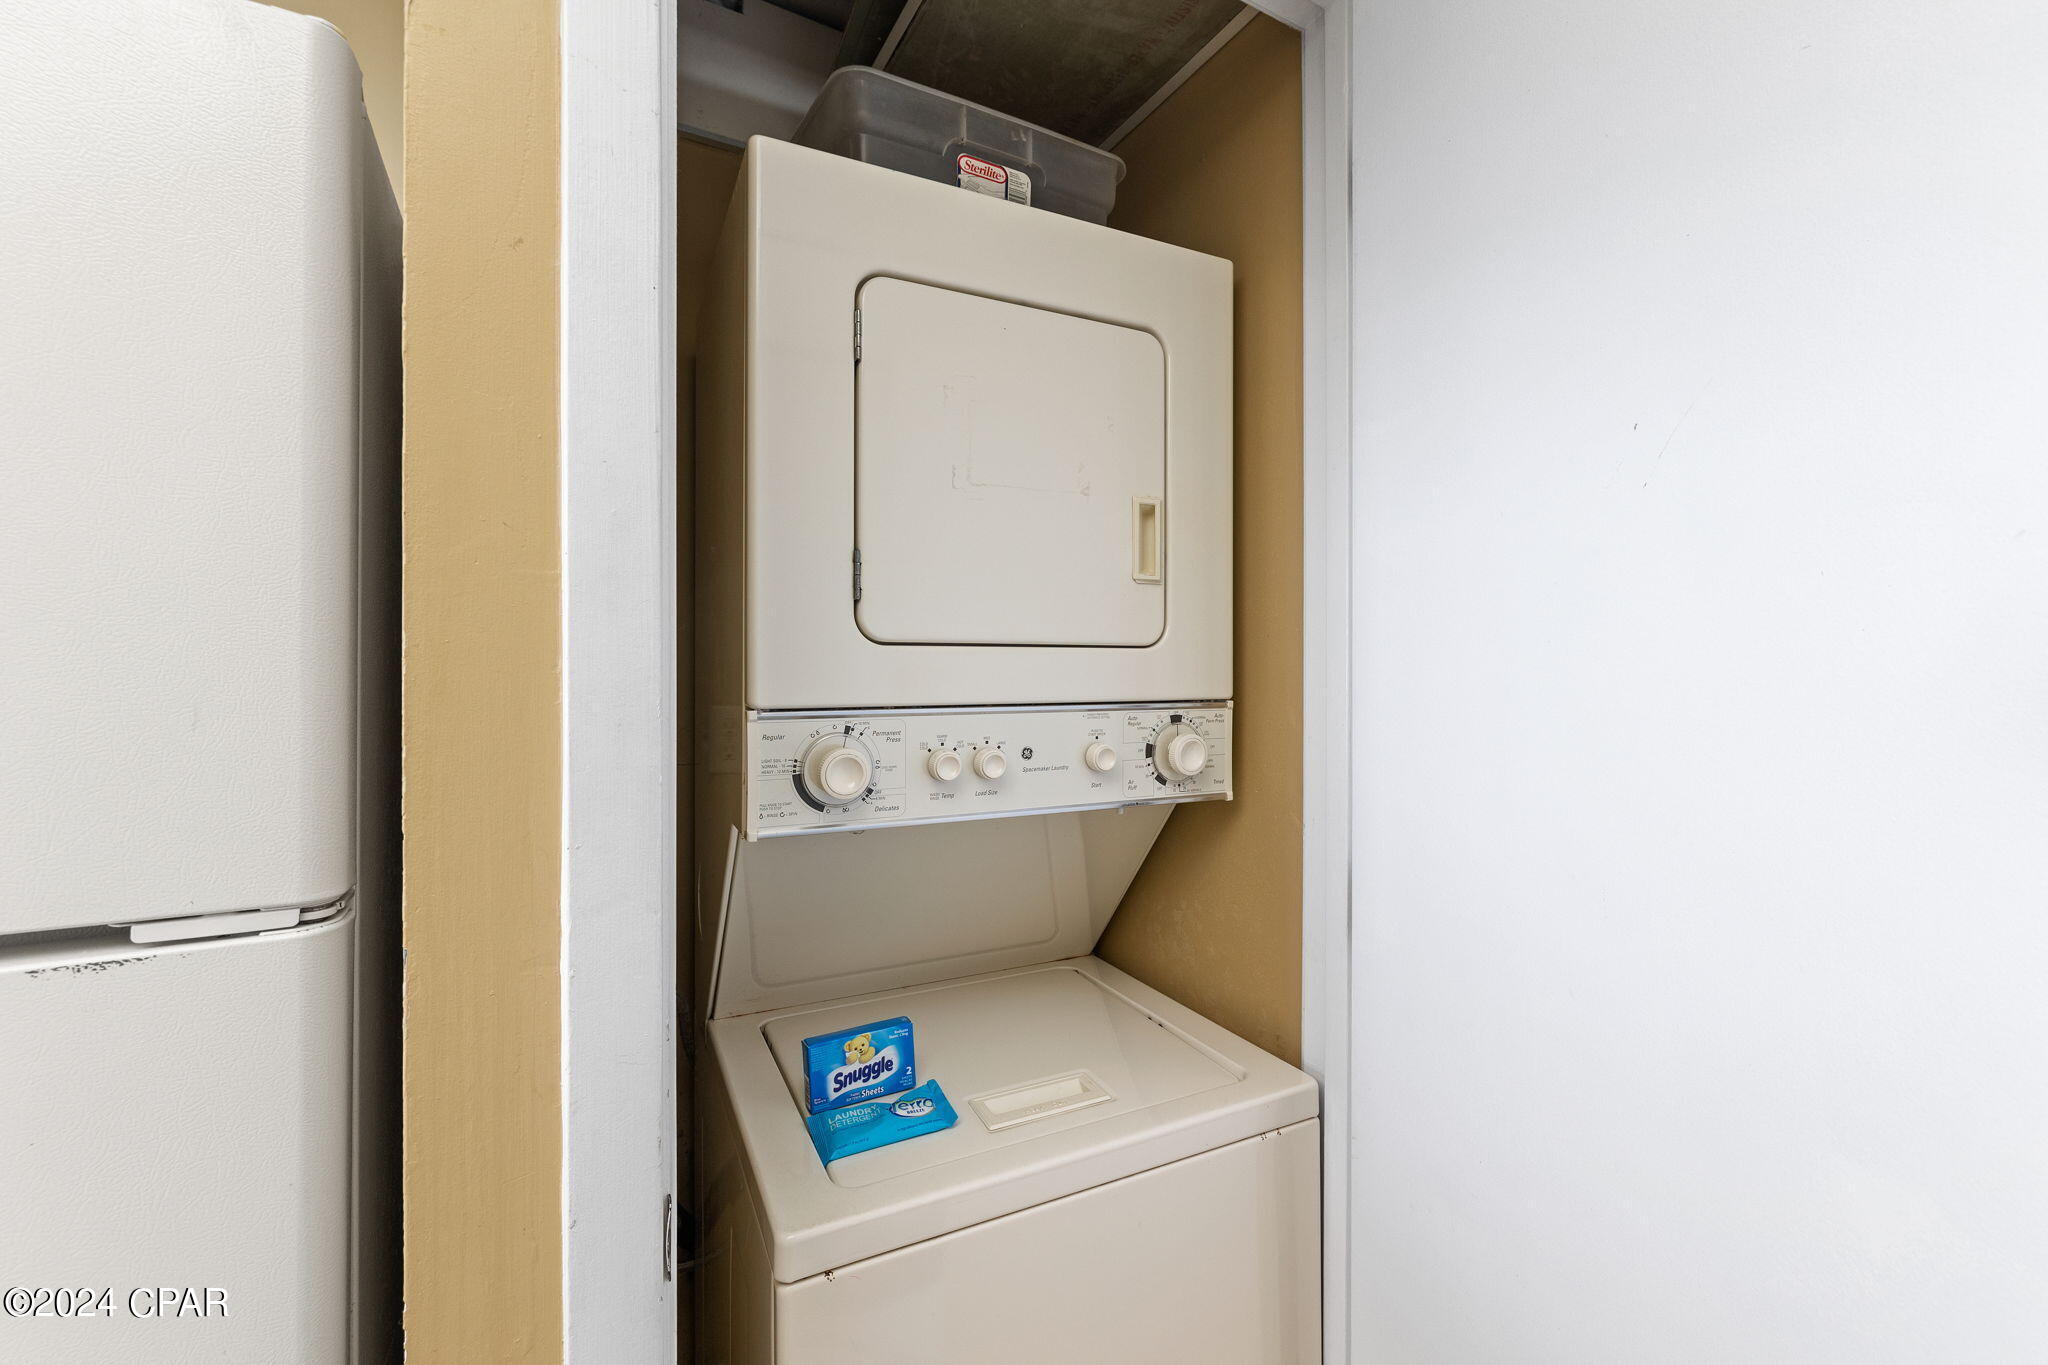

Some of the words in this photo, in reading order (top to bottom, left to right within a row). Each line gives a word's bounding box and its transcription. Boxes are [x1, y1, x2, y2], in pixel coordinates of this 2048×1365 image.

[964, 160, 1002, 180] Sterilite
[761, 734, 786, 742] Regular
[941, 792, 955, 800] Temp
[874, 805, 900, 813] Delicates
[833, 1056, 894, 1093] Snuggle
[906, 1066, 912, 1075] 2
[861, 1086, 884, 1098] Sheets
[828, 1103, 877, 1125] LAUNDRY
[830, 1107, 881, 1132] DETERGENT
